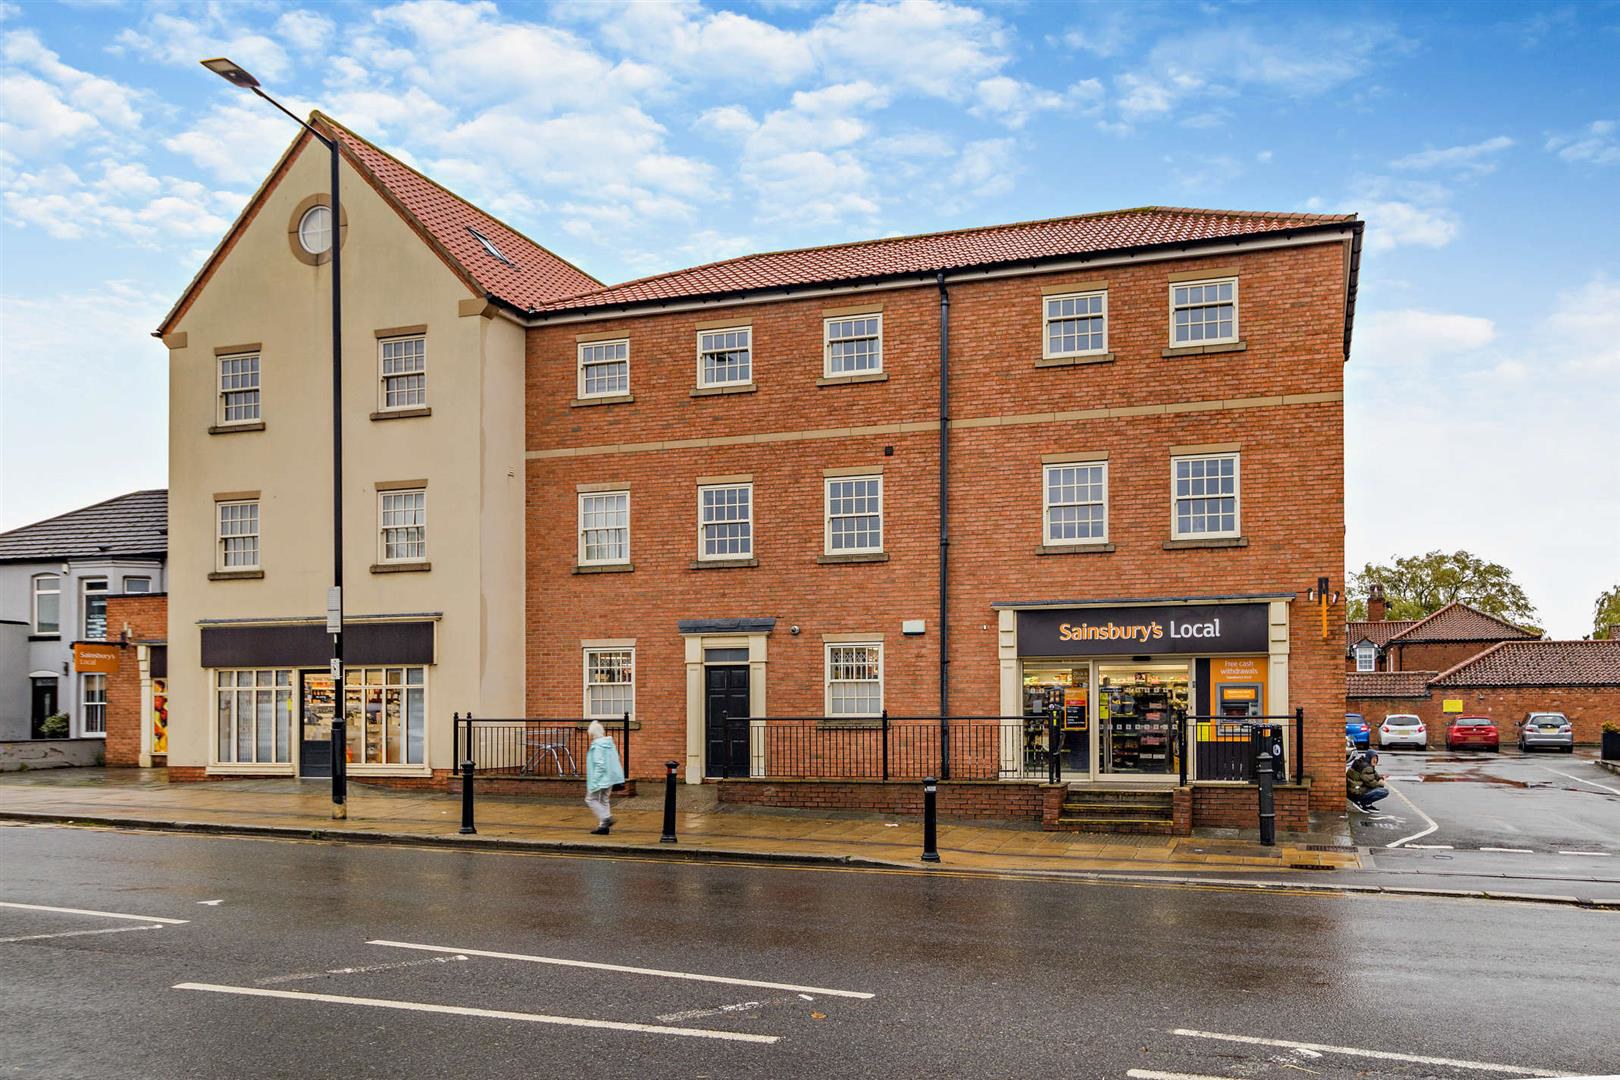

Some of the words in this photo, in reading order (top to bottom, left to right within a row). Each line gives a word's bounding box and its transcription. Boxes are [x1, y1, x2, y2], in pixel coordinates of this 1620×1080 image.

[1059, 621, 1163, 643] Sainsbury's
[1170, 618, 1221, 638] Local
[1220, 667, 1258, 675] withdrawals
